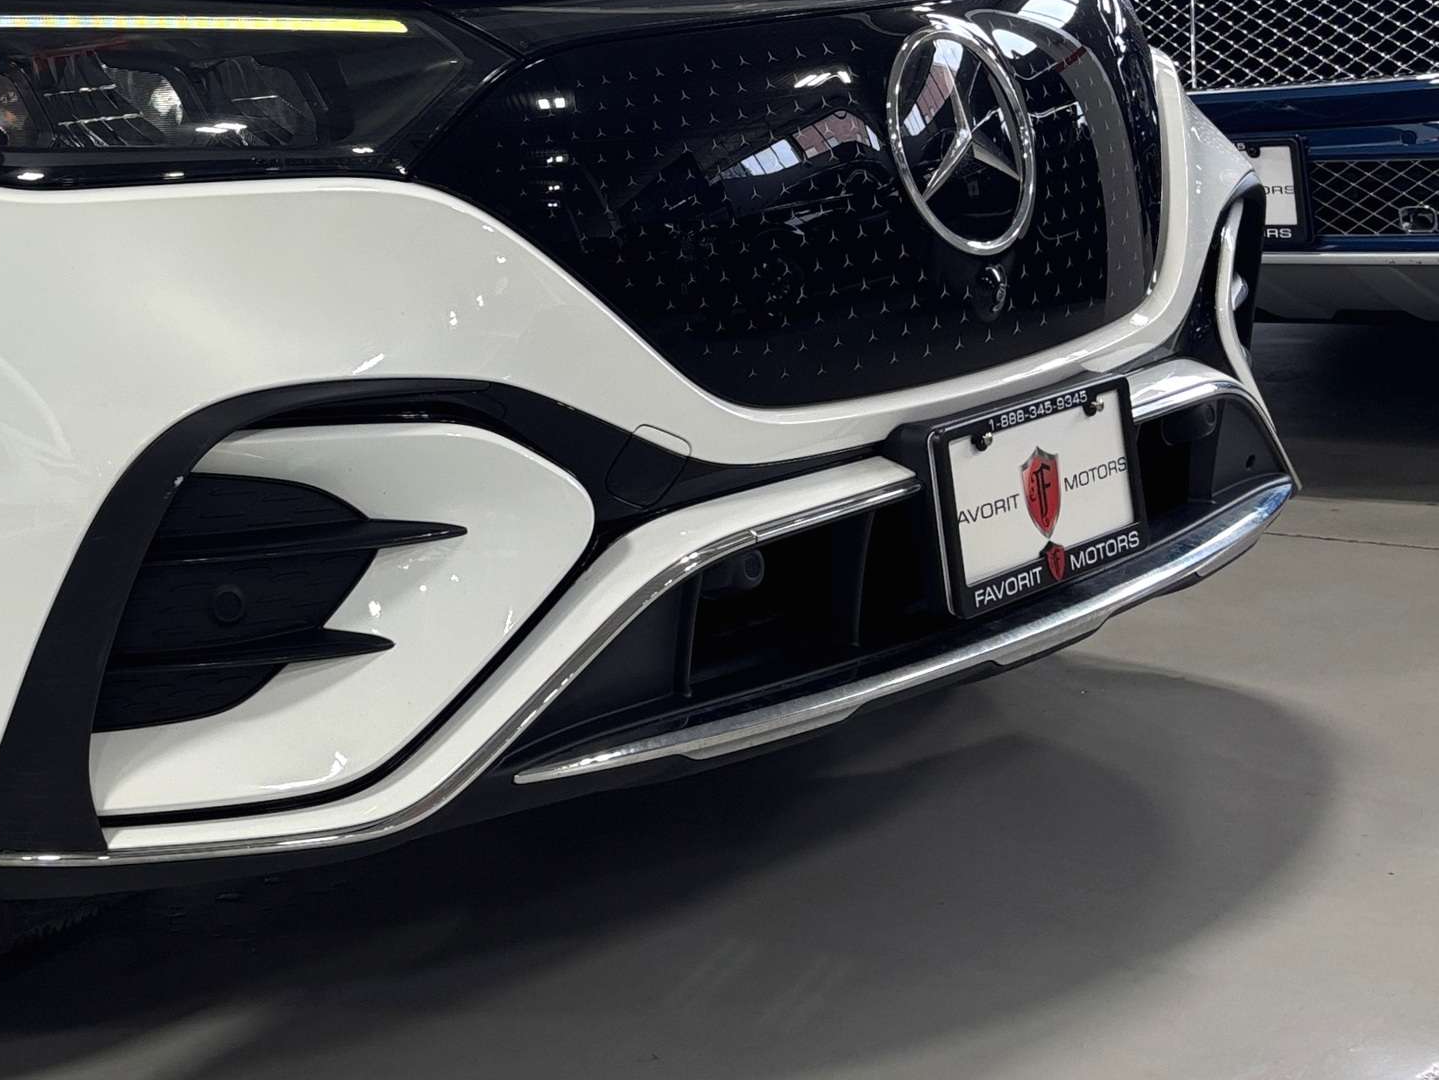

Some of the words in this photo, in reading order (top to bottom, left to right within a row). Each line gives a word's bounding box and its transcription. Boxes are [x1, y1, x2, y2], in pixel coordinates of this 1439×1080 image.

[988, 391, 1089, 432] 1-888-345-9345
[957, 493, 1020, 525] AVORIT
[1064, 456, 1129, 492] MOTORS
[974, 567, 1042, 608] FAVORIT
[1070, 530, 1140, 571] MOTORS
